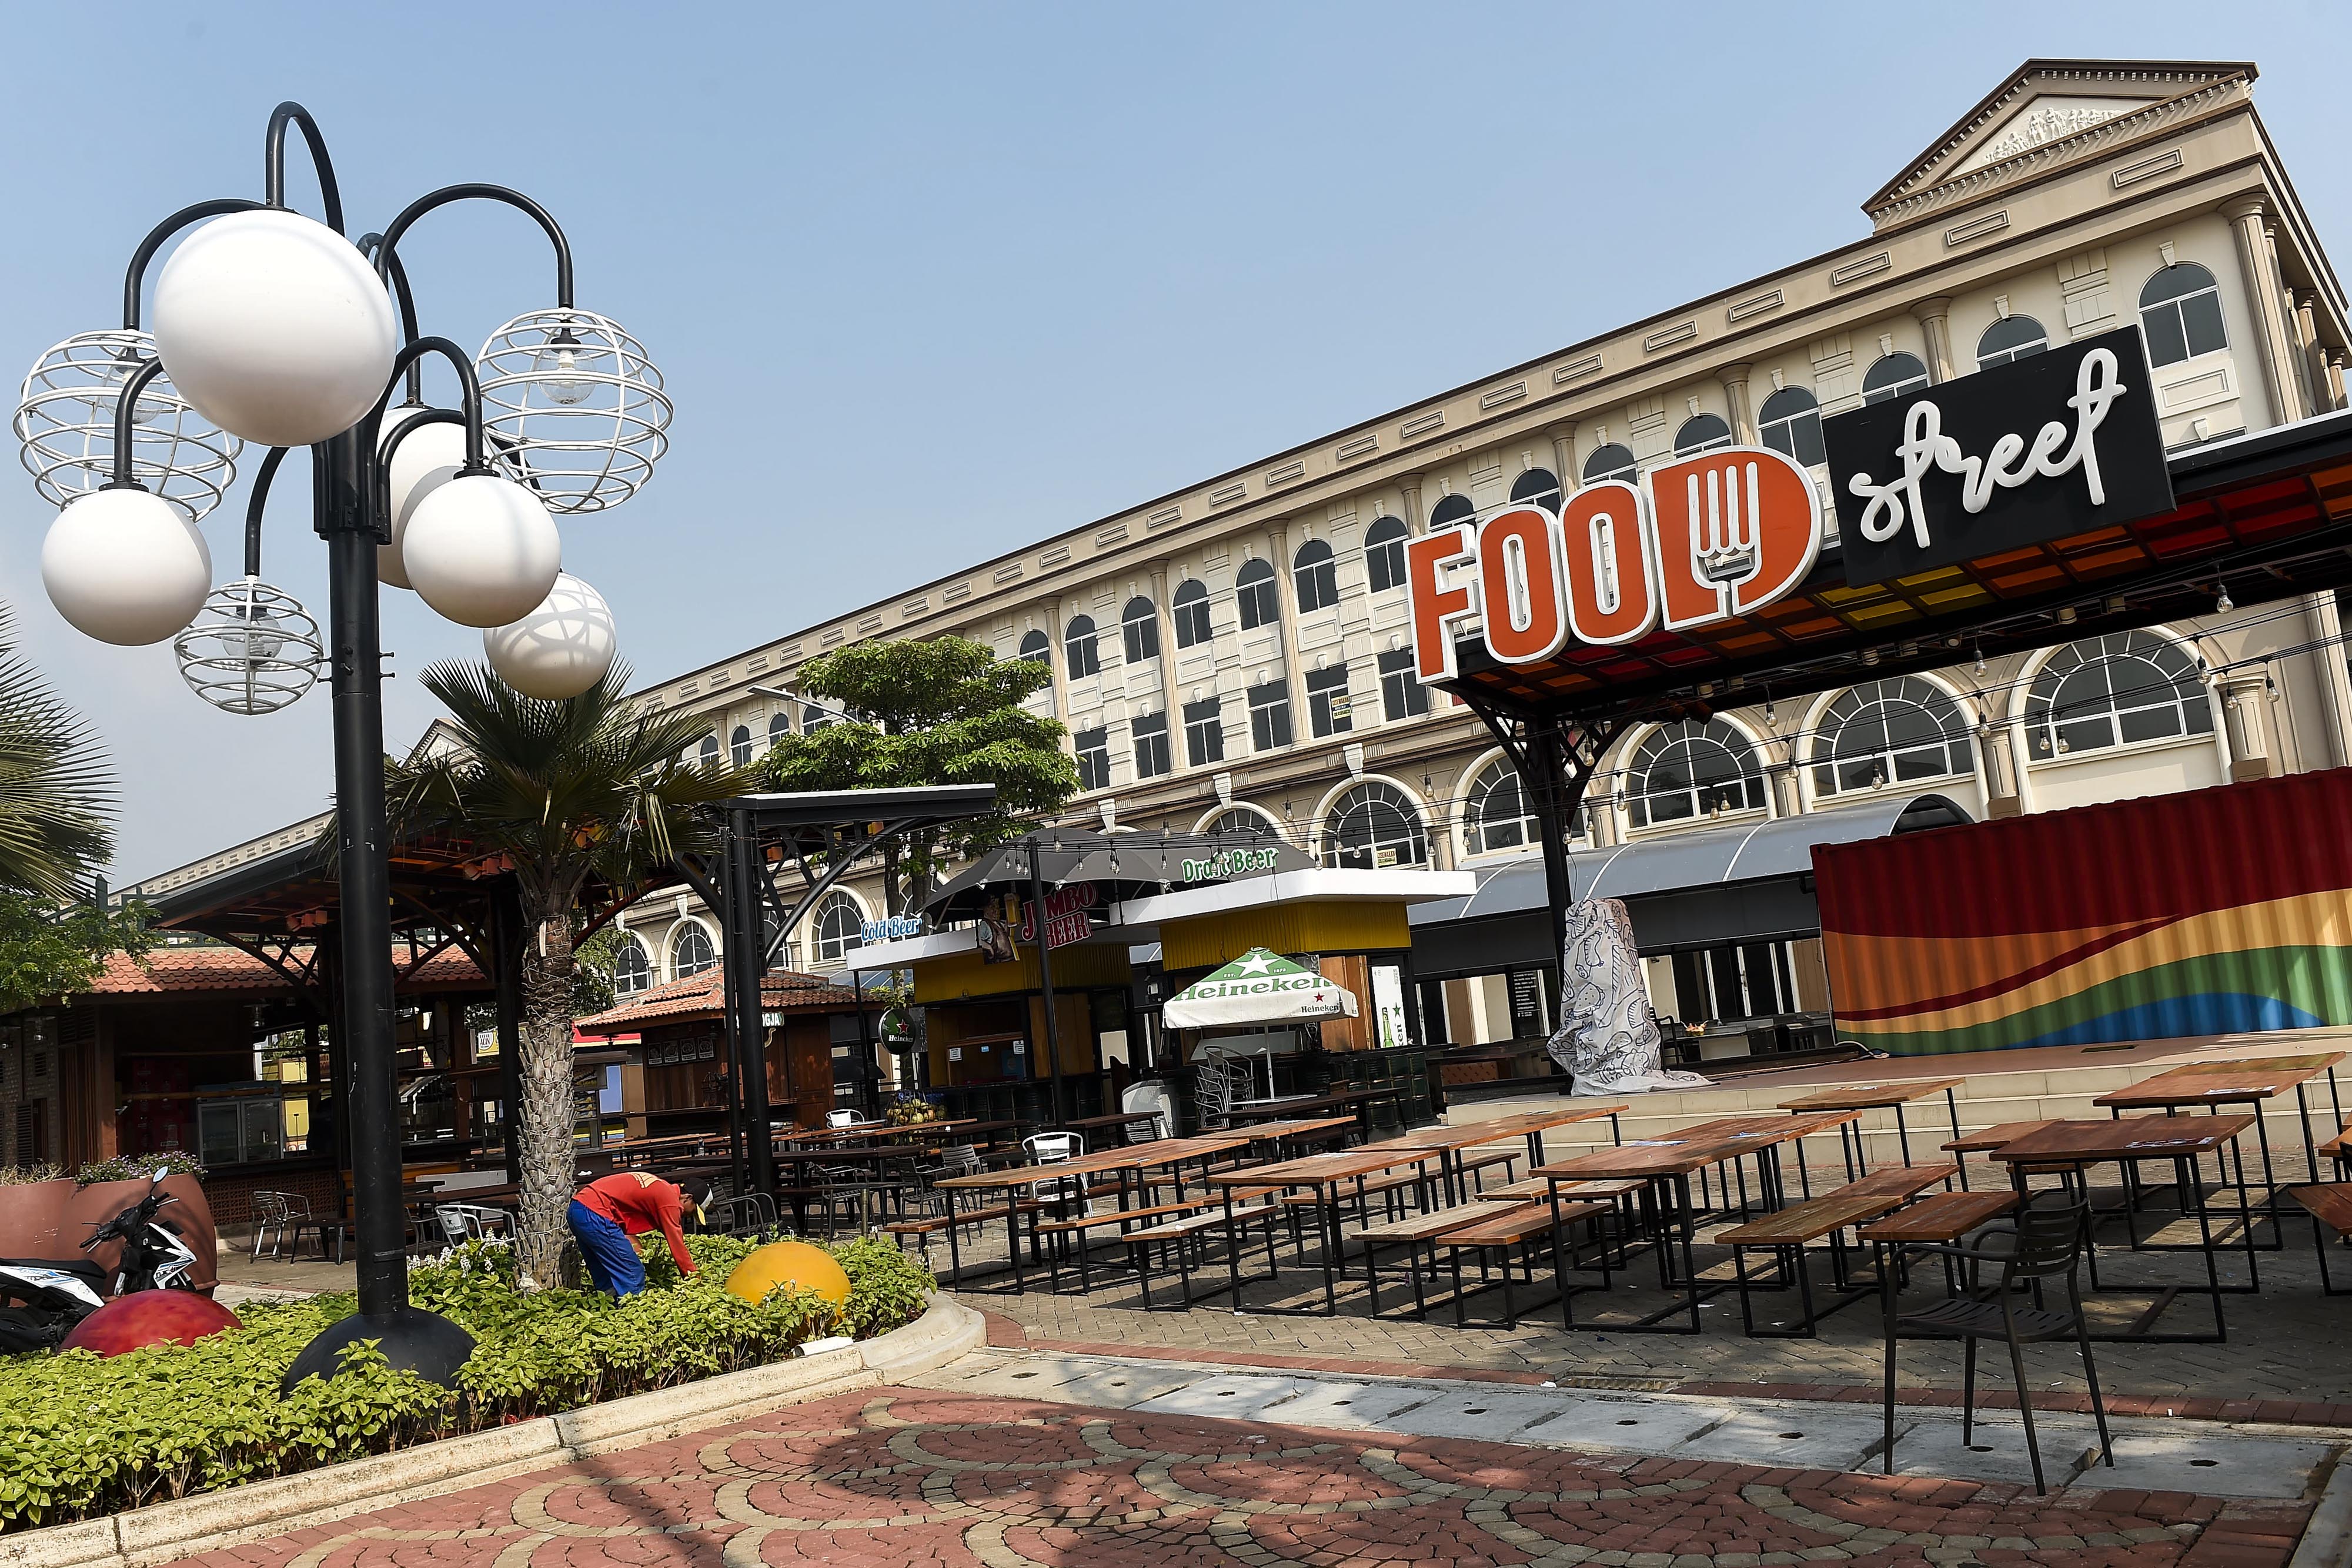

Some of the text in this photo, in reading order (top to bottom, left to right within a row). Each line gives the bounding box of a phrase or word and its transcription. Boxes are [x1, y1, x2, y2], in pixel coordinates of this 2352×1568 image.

[1403, 348, 2127, 686] FOOD street
[1231, 847, 1280, 873] Beer
[861, 915, 923, 941] Cold Beer
[1044, 911, 1092, 951] BEER
[1172, 977, 1333, 1002] Heineken
[1301, 1004, 1339, 1013] Heineken
[888, 1034, 913, 1042] Heineken
